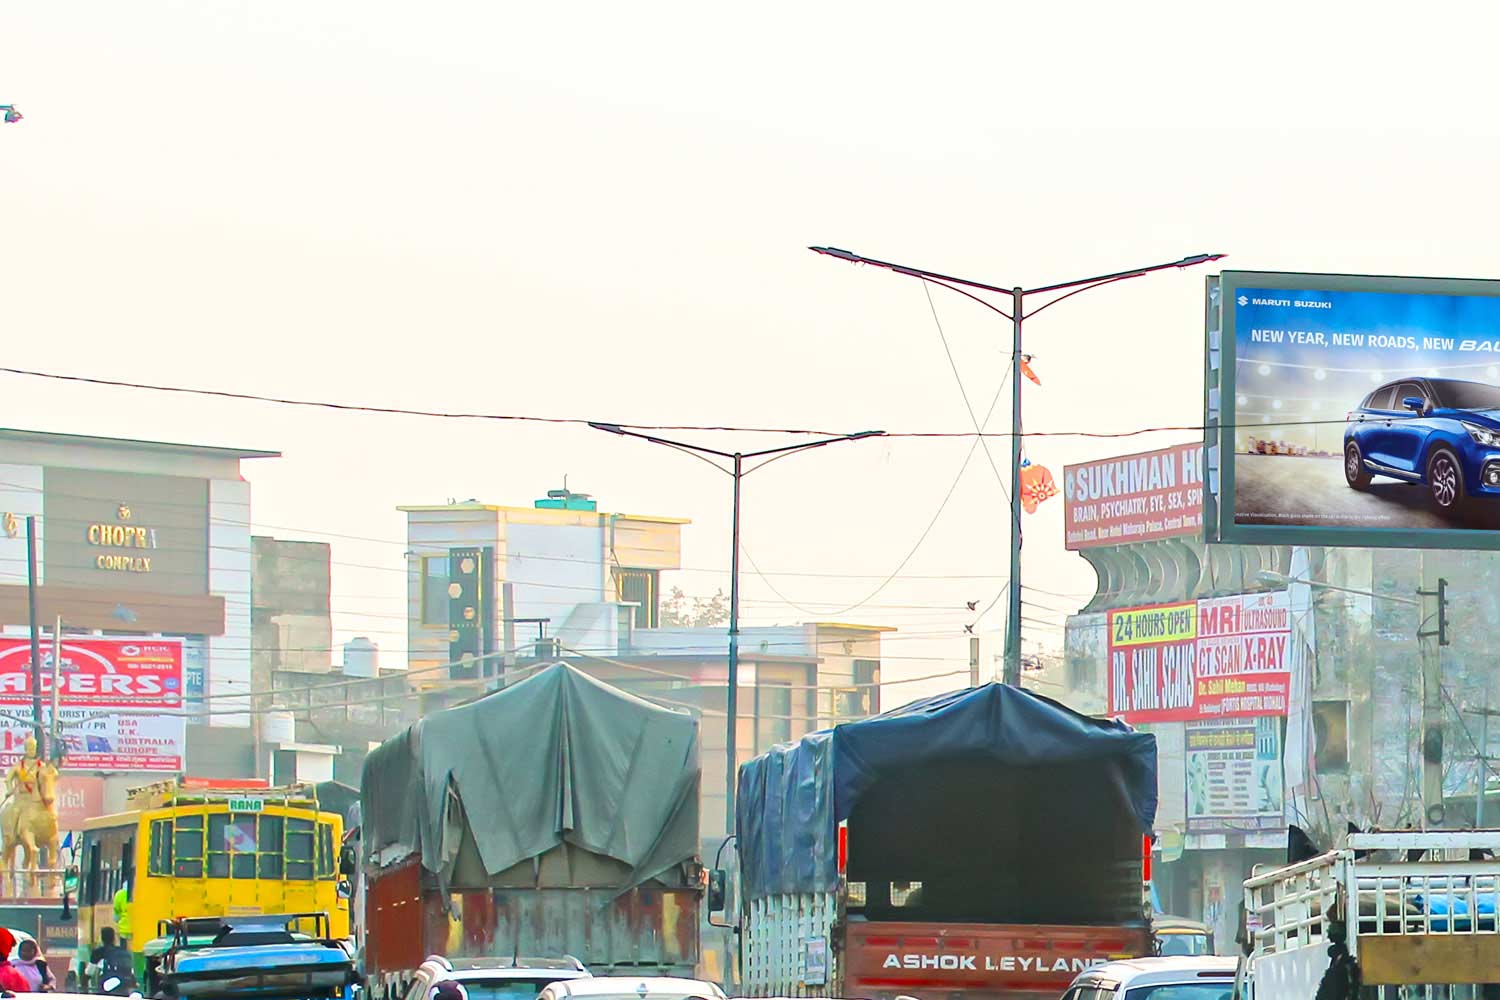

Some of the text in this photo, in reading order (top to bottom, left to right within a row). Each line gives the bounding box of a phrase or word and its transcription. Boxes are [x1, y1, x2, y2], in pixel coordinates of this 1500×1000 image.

[1252, 297, 1331, 309] MARUTI SUZUKI
[1251, 329, 1284, 343] NEW
[1288, 330, 1329, 348] YEAR,
[1332, 333, 1364, 347] NEW
[1368, 335, 1419, 351] ROADS,
[1423, 338, 1454, 350] NEW
[1076, 453, 1176, 501] SUKHMAN
[1101, 497, 1149, 519] PSYCHIATRY,
[1150, 495, 1166, 512] EYE,
[1168, 492, 1186, 509] SEX,
[88, 524, 157, 549] CHOPRA
[97, 555, 152, 572] COMPLEX
[1115, 609, 1191, 642] 24 HOURS OPEN
[1201, 605, 1240, 635] MRI
[1243, 608, 1286, 630] ULTRASOUND
[1200, 644, 1240, 675] CT SCAN
[1244, 636, 1286, 671] X-RAY
[1132, 646, 1159, 711] SAHIL
[1162, 643, 1195, 710] SCANS
[47, 710, 86, 719] TURIST
[117, 719, 138, 727] USA
[230, 800, 262, 810] RANA
[883, 953, 977, 970] ASHOK
